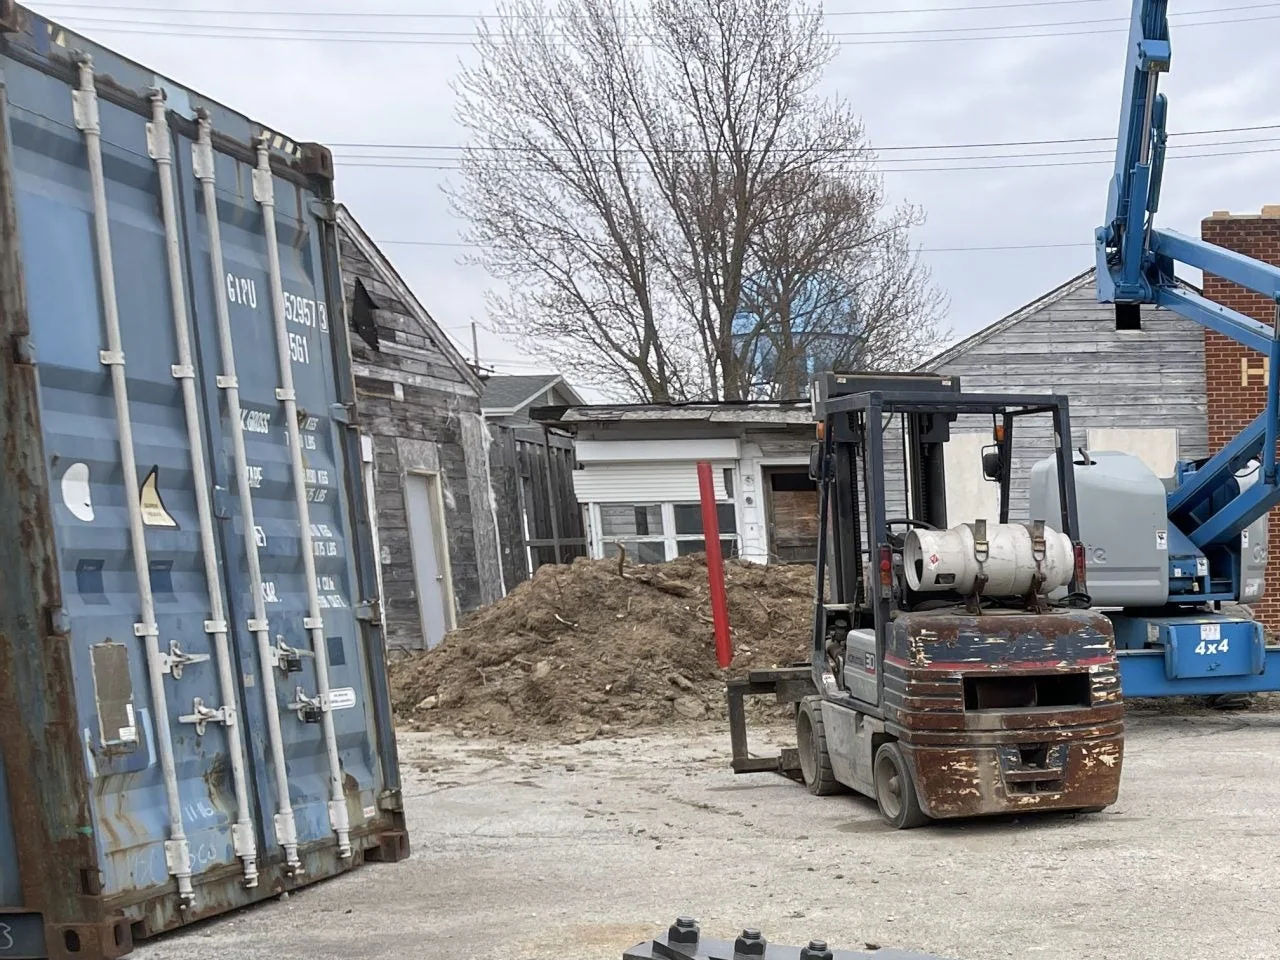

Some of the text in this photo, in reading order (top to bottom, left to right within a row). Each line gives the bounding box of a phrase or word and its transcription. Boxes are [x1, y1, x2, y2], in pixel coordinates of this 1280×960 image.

[283, 291, 316, 328] 52957
[288, 332, 310, 364] 5G1
[1195, 638, 1229, 655] 4x4
